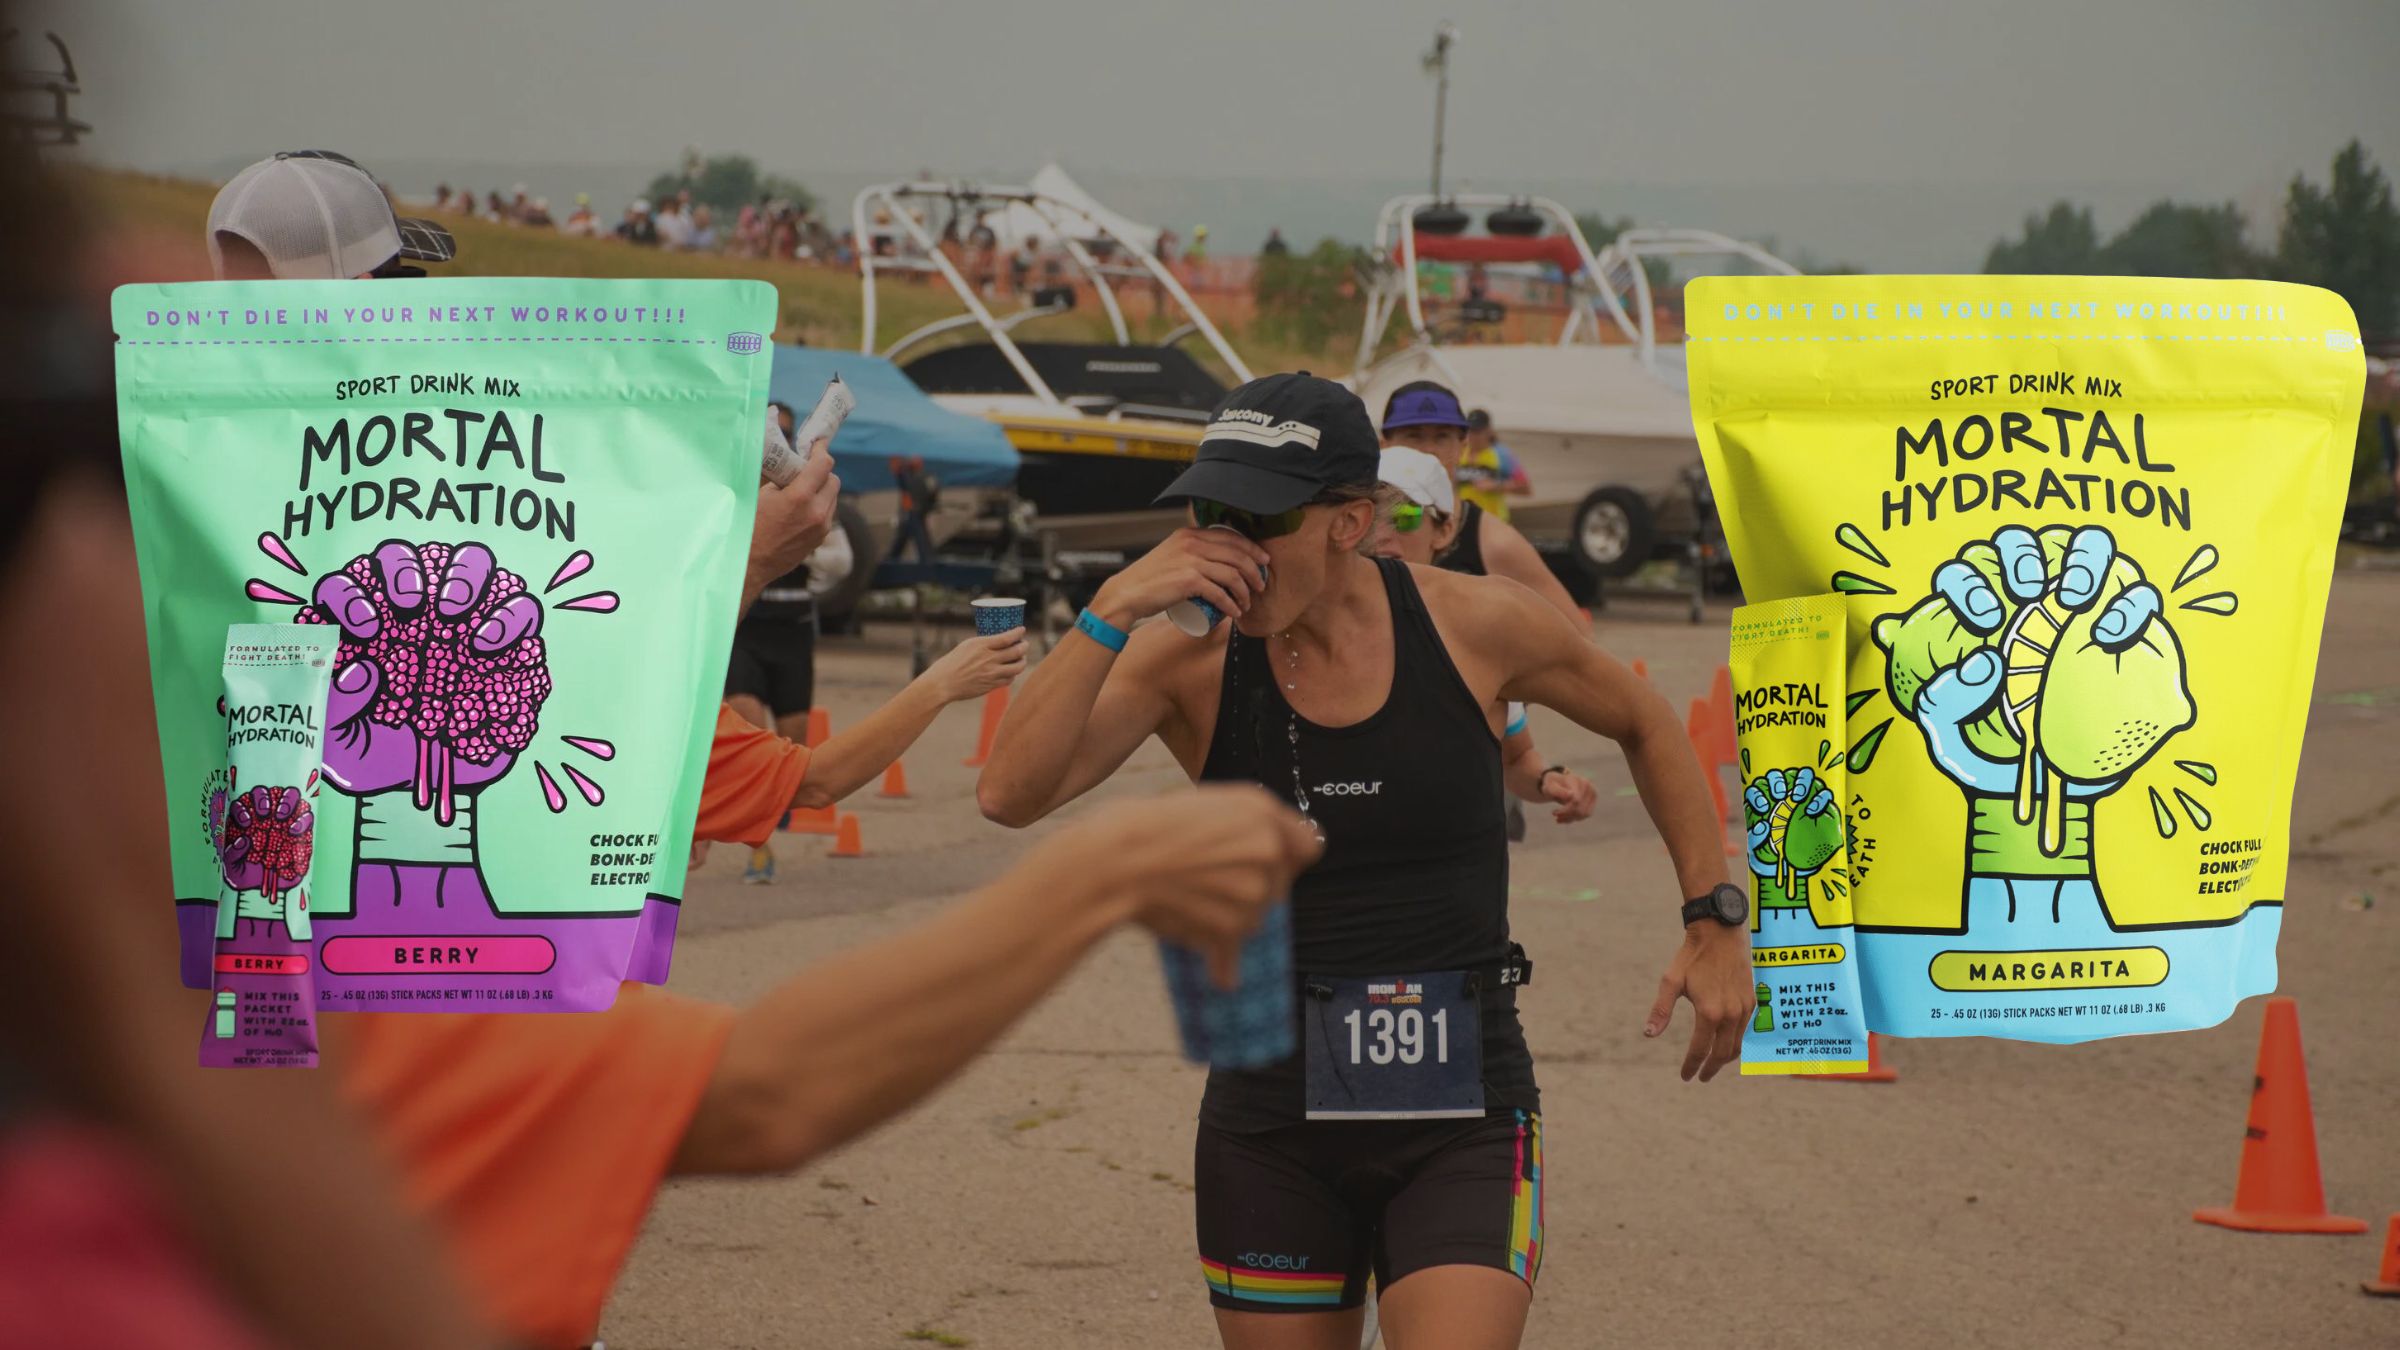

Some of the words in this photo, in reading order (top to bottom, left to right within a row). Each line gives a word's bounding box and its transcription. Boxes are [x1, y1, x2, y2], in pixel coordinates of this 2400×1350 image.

[146, 308, 230, 326] DON'T
[244, 308, 288, 325] DIE
[302, 308, 329, 324] IN
[344, 307, 415, 323] YOUR
[429, 306, 496, 322] NEXT
[511, 306, 687, 324] WORKOUT!!!
[1724, 303, 1815, 321] DON'T
[1832, 303, 1879, 320] DIE
[1895, 303, 1924, 320] IN
[1938, 303, 2012, 320] YOUR
[2029, 302, 2099, 319] NEXT
[2115, 302, 2287, 322] WORKOUT!!!
[336, 374, 401, 401] SPORT
[410, 373, 475, 397] DRINK
[484, 376, 521, 398] MIX
[1931, 373, 1999, 401] SPORT
[2008, 371, 2075, 396] DRINK
[2085, 376, 2123, 399] MIX
[299, 408, 566, 491] MORTAL
[1895, 406, 2176, 482] MORTAL
[1881, 469, 2192, 531] HYDRATION
[283, 478, 576, 542] HYDRATION
[1731, 617, 1804, 632] FORMULATED
[1769, 626, 1810, 637] DEATH!
[1736, 683, 1829, 720] MORTAL
[228, 704, 318, 732] MORTAL
[1738, 711, 1826, 736] HYDRATION
[228, 728, 315, 749] HYDRATION
[1322, 780, 1383, 796] coeur
[201, 769, 229, 845] FORMULATE
[590, 834, 645, 847] CHOCK
[2200, 840, 2242, 855] CHOCK
[2244, 838, 2262, 852] FULL
[590, 853, 655, 866] BONK-DE
[1849, 838, 1877, 888] EATH
[591, 872, 648, 885] ELECTRO
[235, 959, 284, 970] BERRY
[394, 948, 480, 964] BERRY
[1968, 960, 2131, 982] MARGARITA
[321, 990, 331, 1000] 25
[355, 990, 366, 1000] OZ
[391, 990, 414, 1000] STICK
[416, 990, 442, 1000] PACKS
[444, 990, 458, 1000] NET
[461, 990, 473, 1000] WT
[475, 990, 484, 999] 11
[487, 990, 497, 1000] OZ
[516, 990, 530, 1001] LB)
[543, 990, 553, 1000] KG
[1780, 985, 1802, 994] MIX
[1806, 982, 1836, 992] THIS
[244, 993, 266, 1001] MIX
[271, 993, 300, 1001] THIS
[1780, 996, 1828, 1007] PACKET
[244, 1005, 292, 1014] PACKET
[1780, 1009, 1814, 1018] WITH
[1931, 1008, 1942, 1019] 25
[1951, 1008, 1964, 1019] .45
[1966, 1008, 1978, 1019] OZ
[1980, 1008, 2001, 1020] (13G)
[2003, 1007, 2028, 1019] STICK
[2029, 1006, 2056, 1018] PACKS
[2058, 1006, 2073, 1017] NET
[2075, 1006, 2088, 1016] WT
[2089, 1005, 2098, 1016] 11
[2100, 1005, 2112, 1016] OZ
[2114, 1004, 2129, 1016] (.68
[2130, 1003, 2143, 1015] LB)
[2146, 1003, 2153, 1014] .3
[2155, 1002, 2166, 1014] KG
[244, 1017, 276, 1025] WITH
[1782, 1021, 1798, 1030] OF
[244, 1028, 259, 1037] OF
[1344, 1008, 1448, 1064] 1391
[1246, 1252, 1310, 1270] coeur
